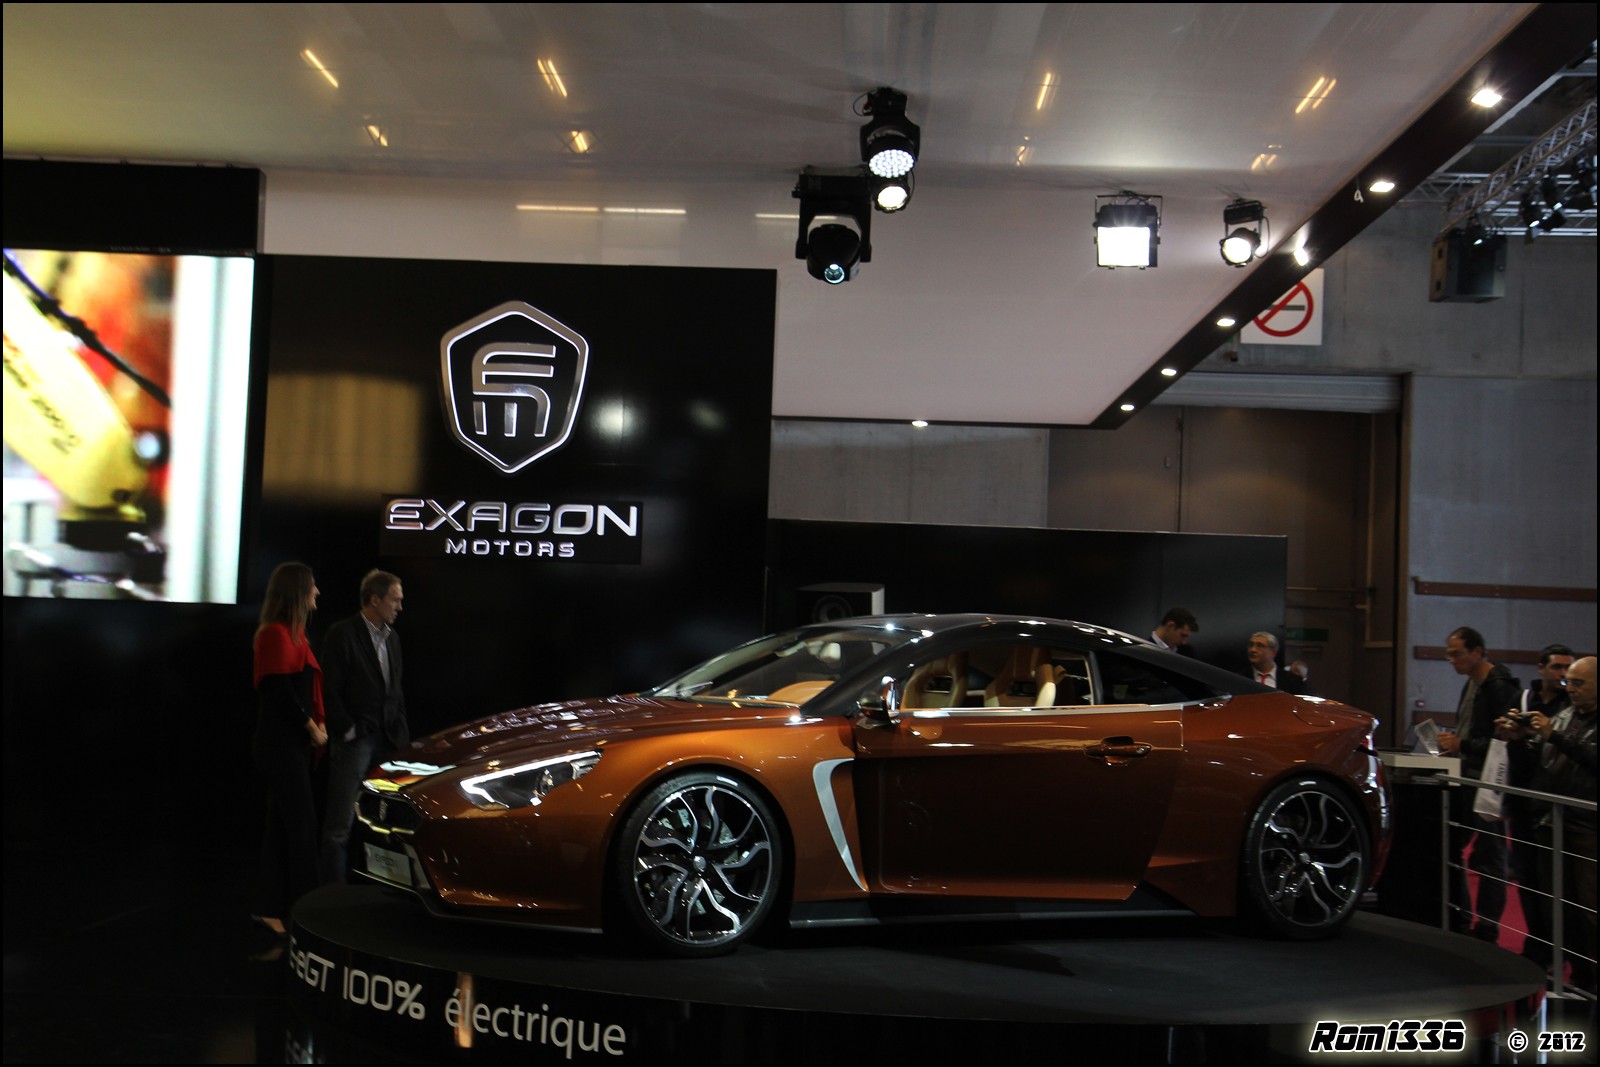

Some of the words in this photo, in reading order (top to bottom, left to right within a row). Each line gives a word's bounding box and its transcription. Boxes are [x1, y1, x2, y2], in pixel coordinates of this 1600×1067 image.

[385, 499, 637, 536] EXAGON
[445, 538, 575, 558] MOTORS
[342, 965, 426, 1020] 100%
[444, 988, 626, 1059] électrique
